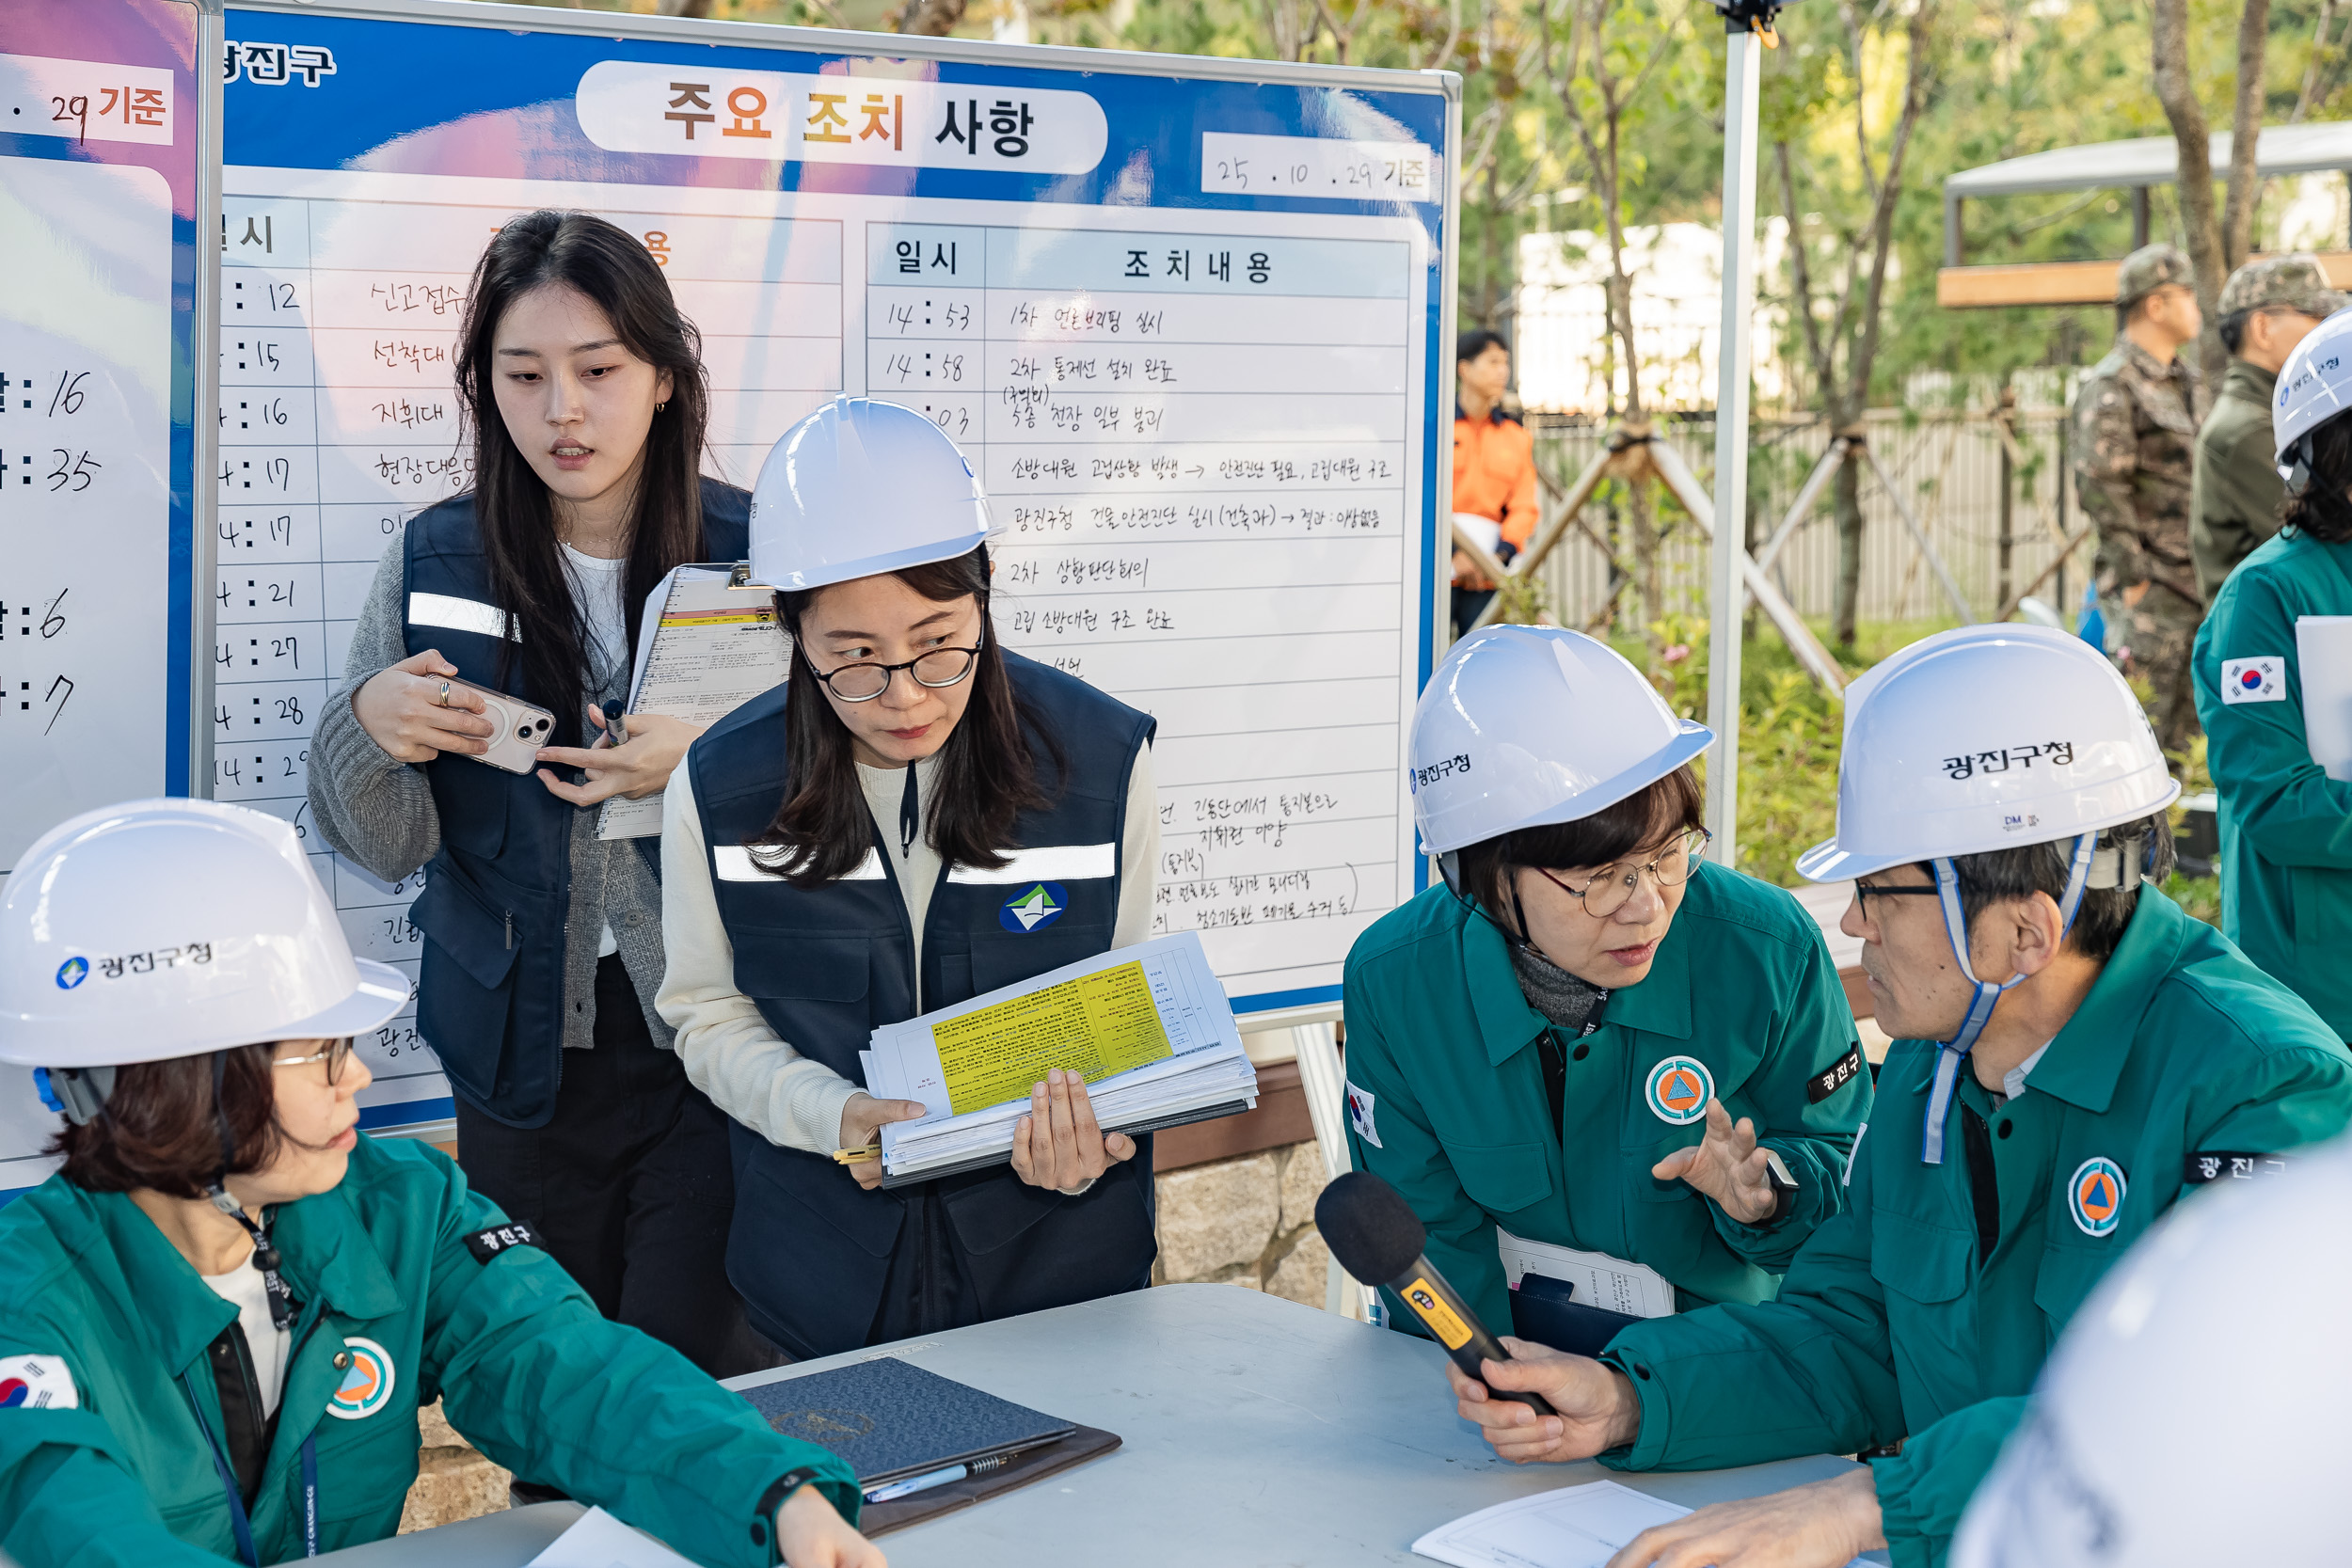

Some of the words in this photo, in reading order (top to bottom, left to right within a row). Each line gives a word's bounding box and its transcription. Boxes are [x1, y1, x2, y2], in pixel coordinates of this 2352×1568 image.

[52, 96, 87, 146] 29
[99, 87, 166, 126] 기준
[664, 82, 771, 140] 주요
[803, 92, 903, 150] 조치
[935, 99, 1034, 157] 사항
[1385, 159, 1425, 187] 기준
[896, 240, 956, 275] 일시
[1010, 302, 1038, 327] 1차
[1136, 310, 1163, 334] 실시
[1010, 356, 1041, 380] 2차
[1054, 356, 1097, 381] 통제선
[1106, 359, 1132, 381] 설치
[1145, 358, 1177, 383] 완료
[372, 399, 443, 429] 지휘대
[1093, 406, 1120, 430] 일부
[1134, 407, 1163, 433] 붕괴
[1012, 456, 1078, 480] 소방대원
[1015, 505, 1073, 531] 광진구청
[1010, 561, 1039, 585] 2차
[1042, 609, 1098, 634] 소방대원
[1111, 610, 1136, 630] 구조
[1146, 608, 1174, 630] 완료
[1418, 753, 1470, 786] 광진구청
[1943, 741, 2074, 780] 광진구청
[98, 942, 213, 979] 광진구청
[1823, 1053, 1860, 1091] 광진구
[481, 1226, 531, 1250] 광진구
